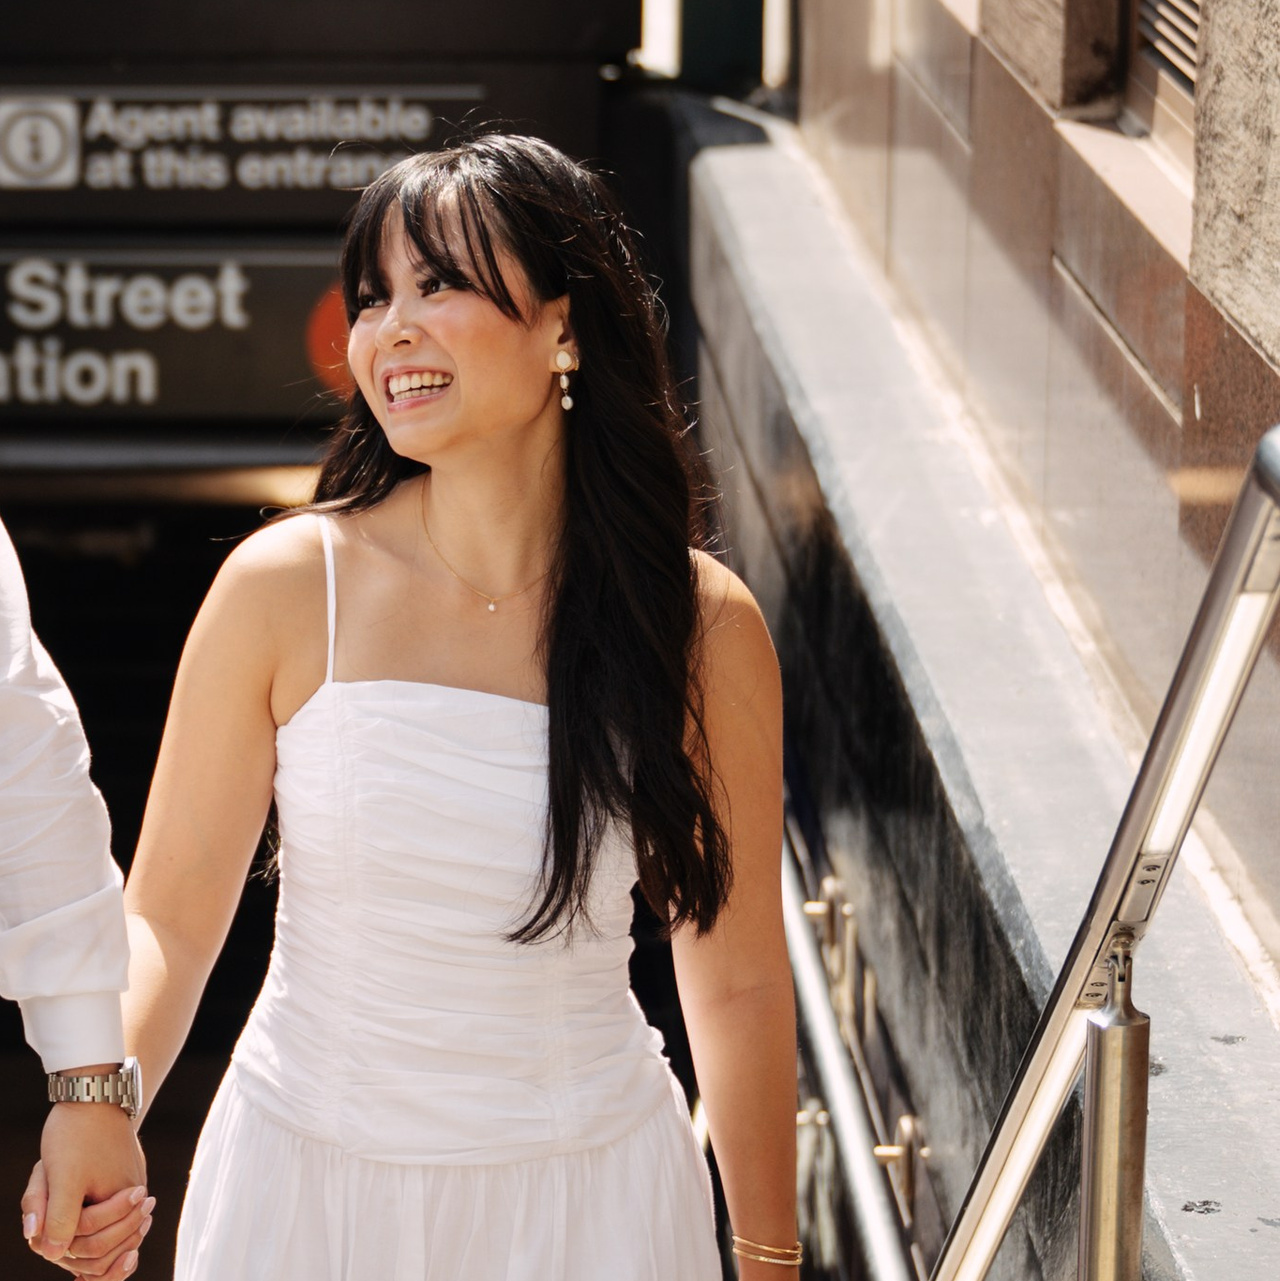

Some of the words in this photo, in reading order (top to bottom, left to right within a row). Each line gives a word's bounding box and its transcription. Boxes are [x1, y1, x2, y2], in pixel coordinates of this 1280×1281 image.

[85, 100, 220, 149] Agent
[230, 100, 433, 143] available
[85, 152, 132, 189] at
[141, 150, 229, 190] this
[236, 151, 408, 189] entran
[6, 257, 251, 330] Street
